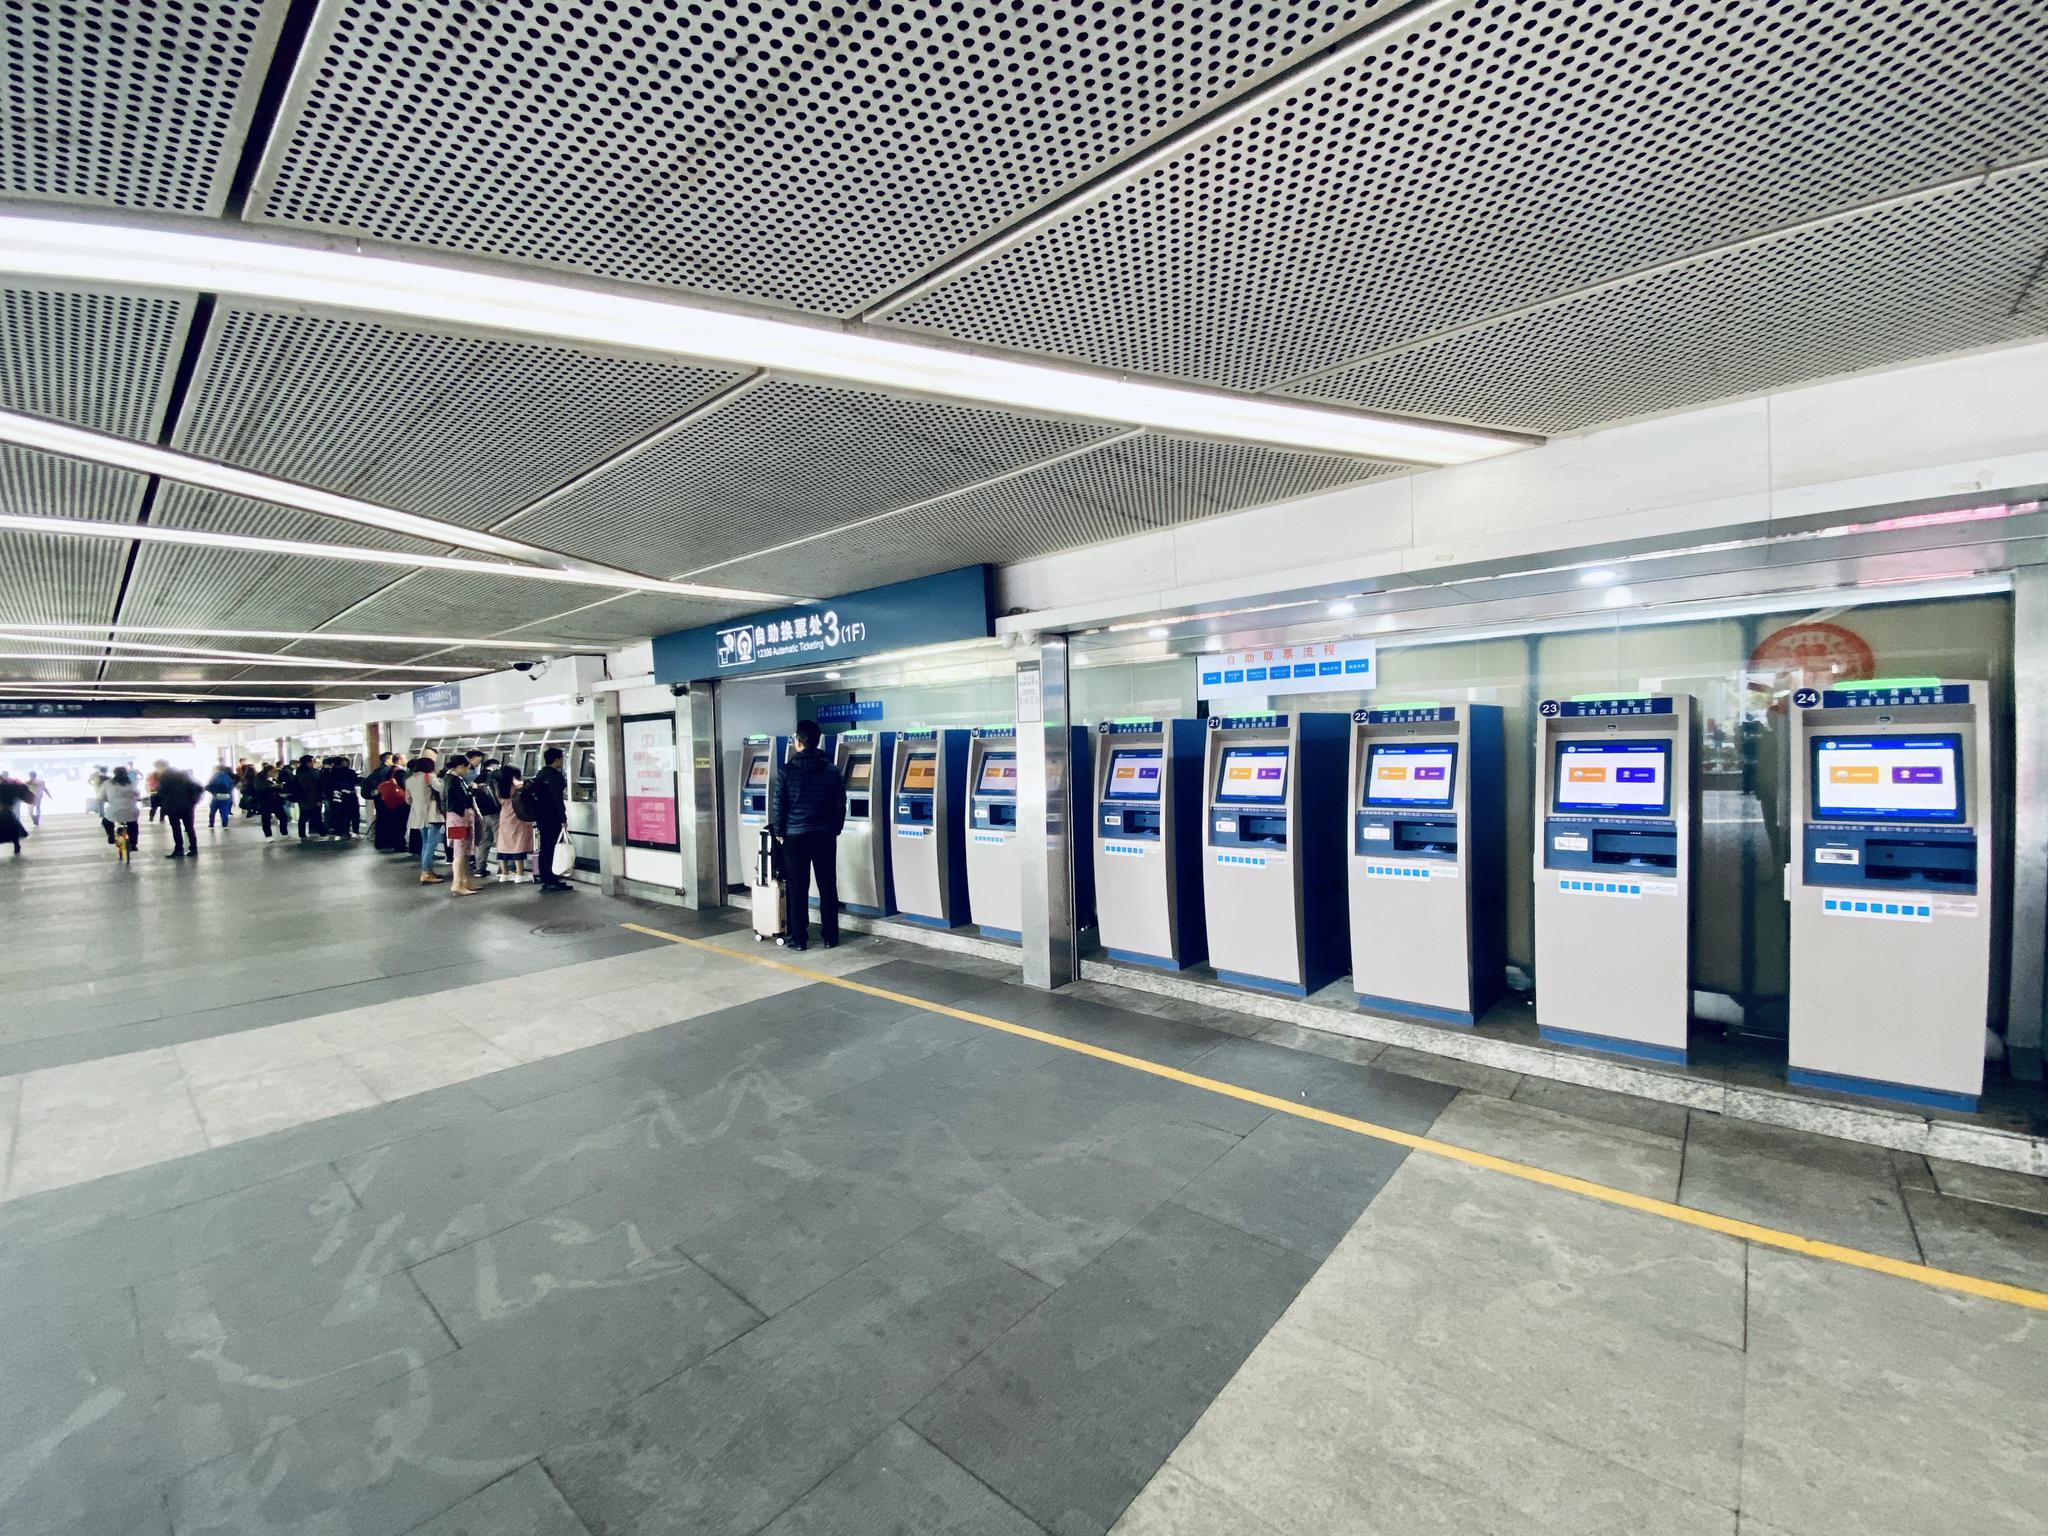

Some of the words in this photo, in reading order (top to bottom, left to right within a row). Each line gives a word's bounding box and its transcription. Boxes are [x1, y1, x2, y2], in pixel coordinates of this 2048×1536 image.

[823, 610, 840, 647] 3
[841, 622, 866, 643] (1F)
[772, 644, 799, 656] Automatic
[799, 640, 824, 651] Ticketing
[1227, 642, 1336, 666] 自助取票流程
[1846, 686, 1944, 698] 二代身份证
[1578, 699, 1653, 709] 二代身份证
[1797, 693, 1817, 704] 24
[1847, 695, 1944, 707] 港澳台自助取票
[1542, 704, 1557, 714] 23
[1354, 712, 1367, 721] 22
[1100, 724, 1108, 732] 20
[1209, 719, 1219, 727] 21
